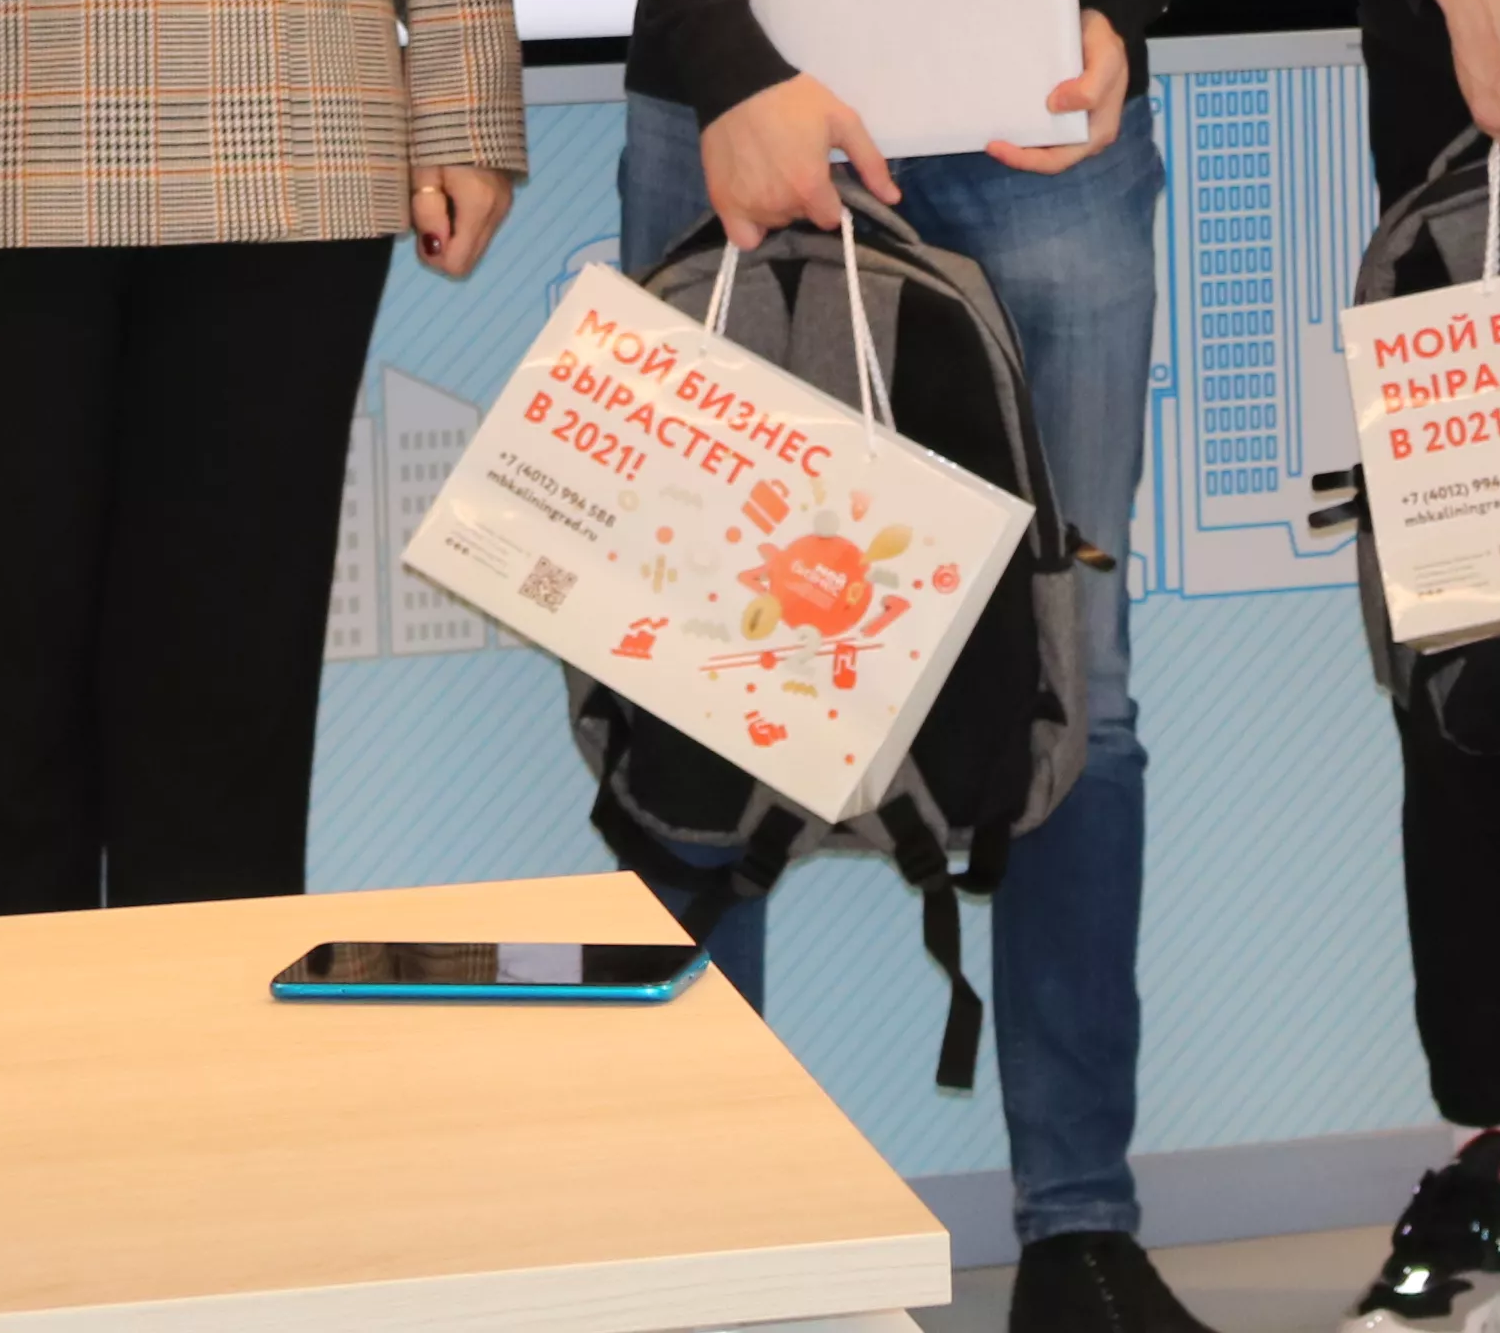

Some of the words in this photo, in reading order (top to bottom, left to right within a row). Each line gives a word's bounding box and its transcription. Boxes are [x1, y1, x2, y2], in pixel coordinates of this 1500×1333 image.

[1374, 313, 1477, 369] МОЙ
[524, 391, 552, 424] В
[551, 407, 647, 482] 2021!
[548, 351, 756, 485] ВЫРАСТЕТ
[575, 308, 679, 385] МОЙ
[675, 368, 833, 479] БИЗНЕС
[1389, 427, 1414, 461] В
